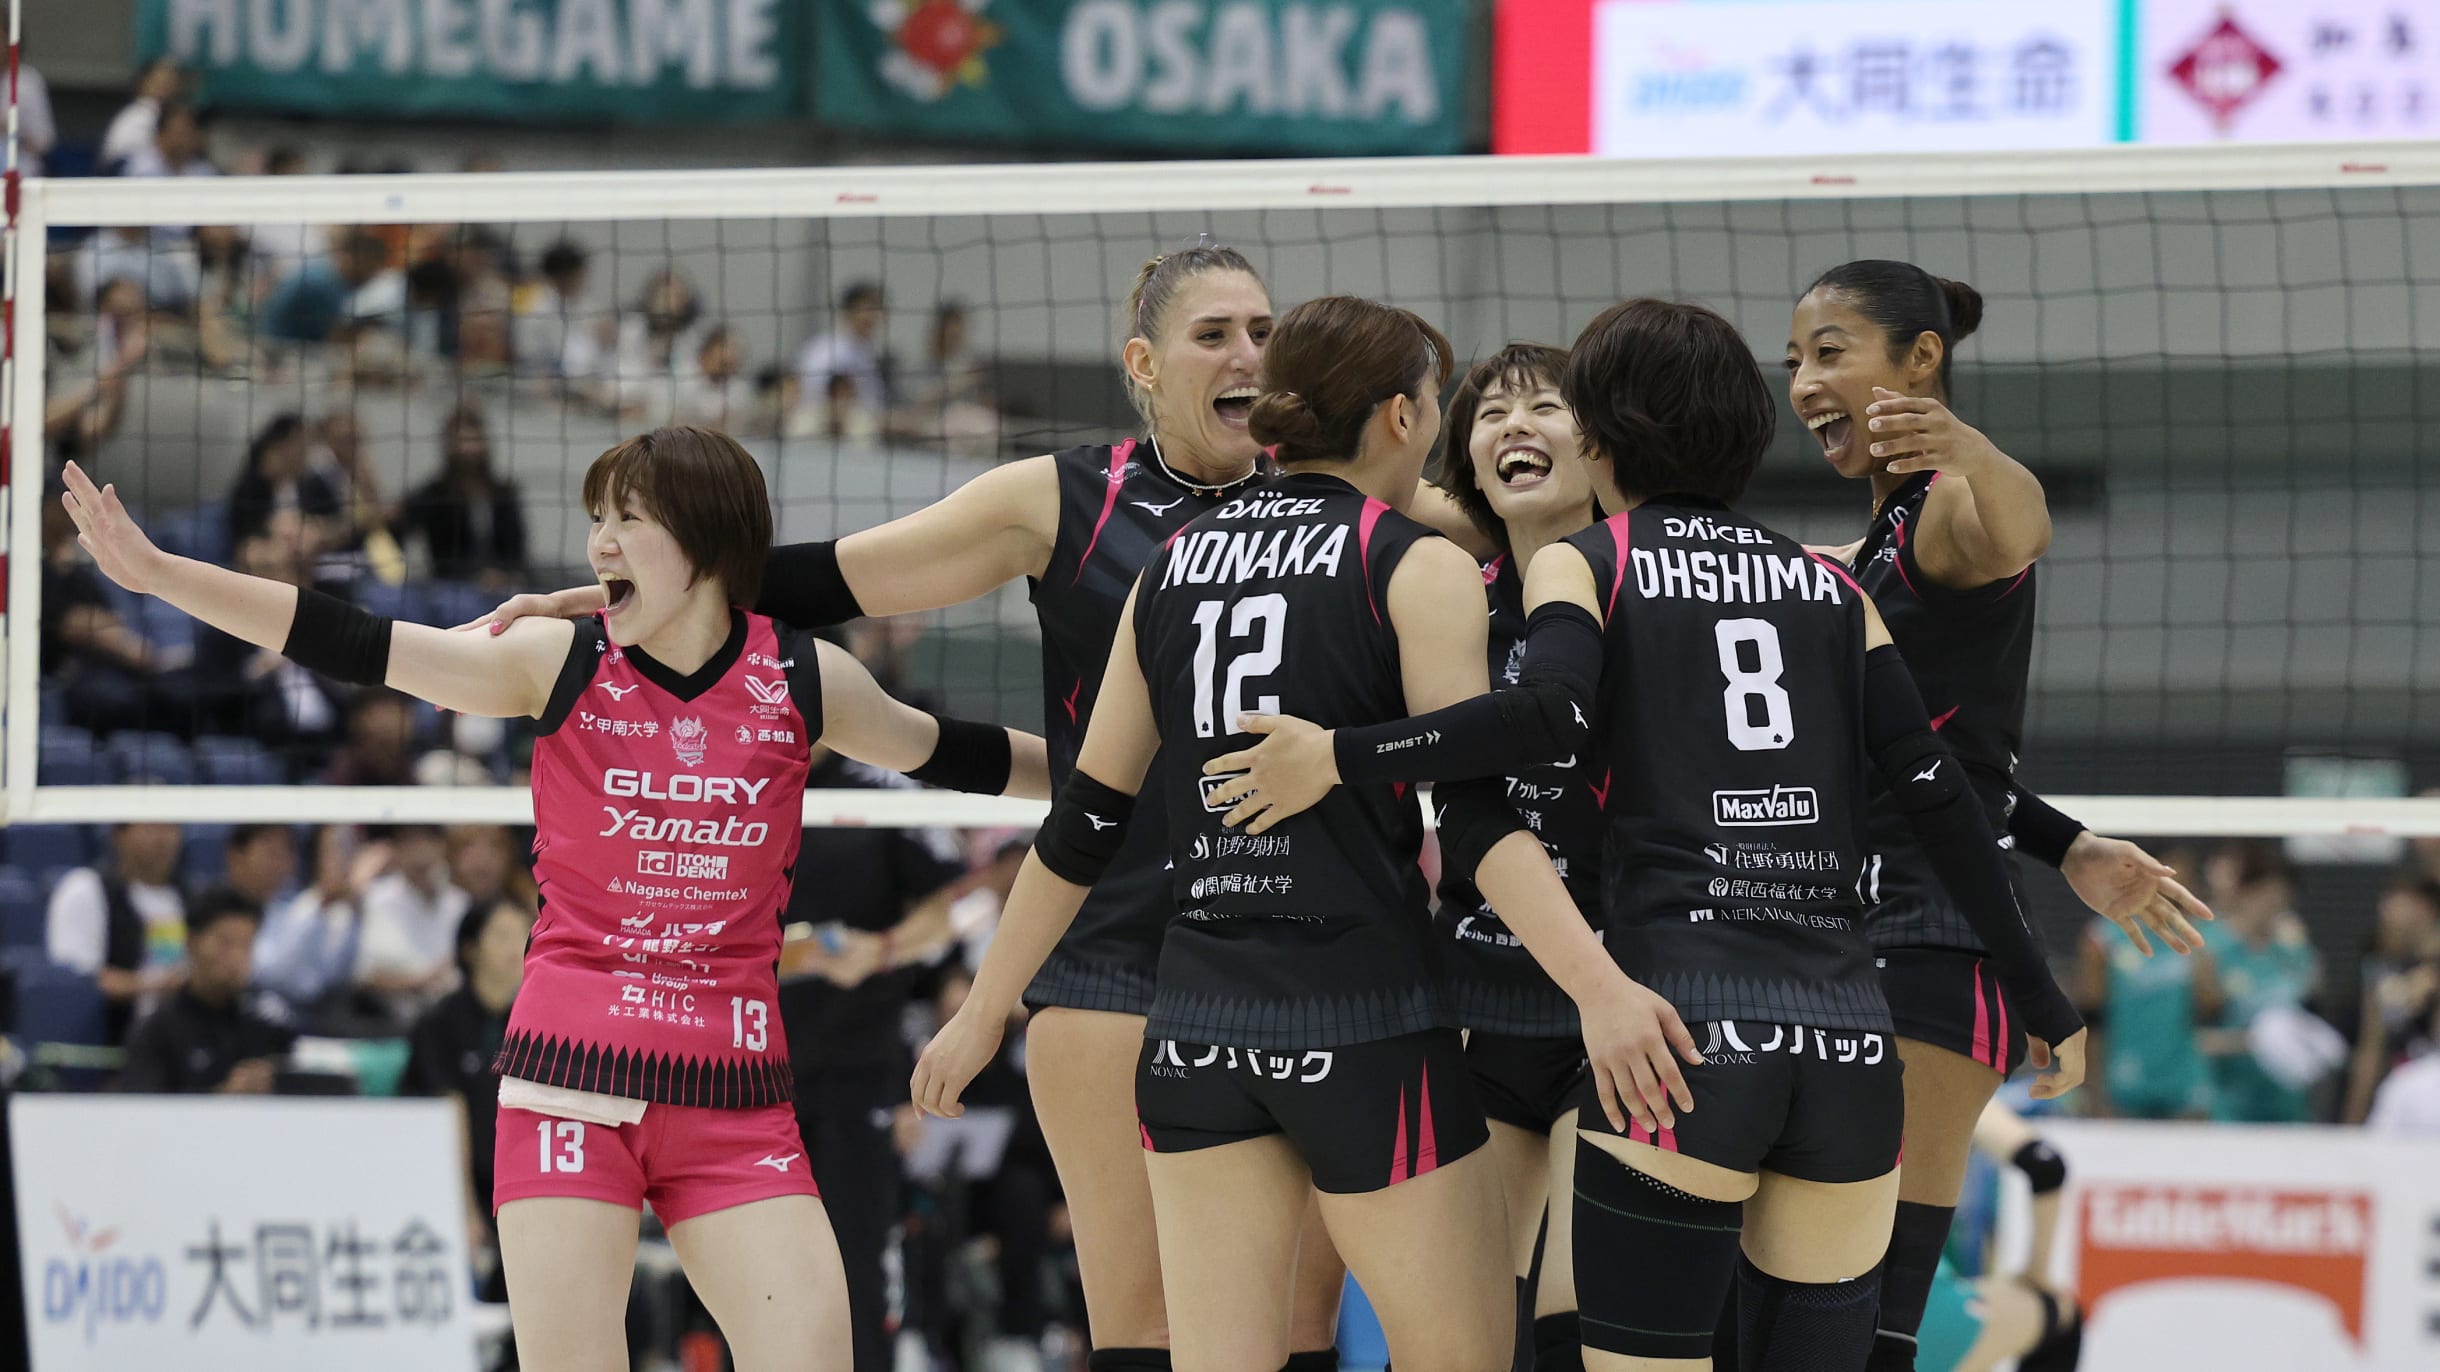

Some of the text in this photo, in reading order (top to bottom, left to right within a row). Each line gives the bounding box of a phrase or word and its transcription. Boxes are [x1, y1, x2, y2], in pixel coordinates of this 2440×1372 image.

[165, 0, 782, 90] HOMEGAME
[1062, 4, 1440, 124] OSAKA
[1762, 40, 2078, 124] 大同生命
[1160, 523, 1350, 591] NONAKA
[1631, 547, 1842, 605] OHSHIMA
[1191, 592, 1288, 738] 12
[1714, 617, 1795, 751] 8
[596, 718, 660, 738] 甲南大学
[757, 728, 796, 744] 西松屋
[603, 767, 771, 805] GLORY
[1721, 784, 1811, 820] MaxValu
[599, 805, 769, 847] Yamato
[676, 865, 727, 880] DENKI
[678, 853, 717, 868] ITOH
[625, 880, 680, 900] Nagase
[1731, 879, 1837, 901] 関西福祉大学
[620, 926, 652, 937] HAMADA
[608, 1004, 705, 1028] 光工業株式会社
[731, 996, 767, 1053] 13
[1150, 1065, 1192, 1079] NOVAC
[1703, 1052, 1758, 1066] NOVAC
[537, 1120, 585, 1173] 13
[183, 1215, 456, 1332] 大同生命
